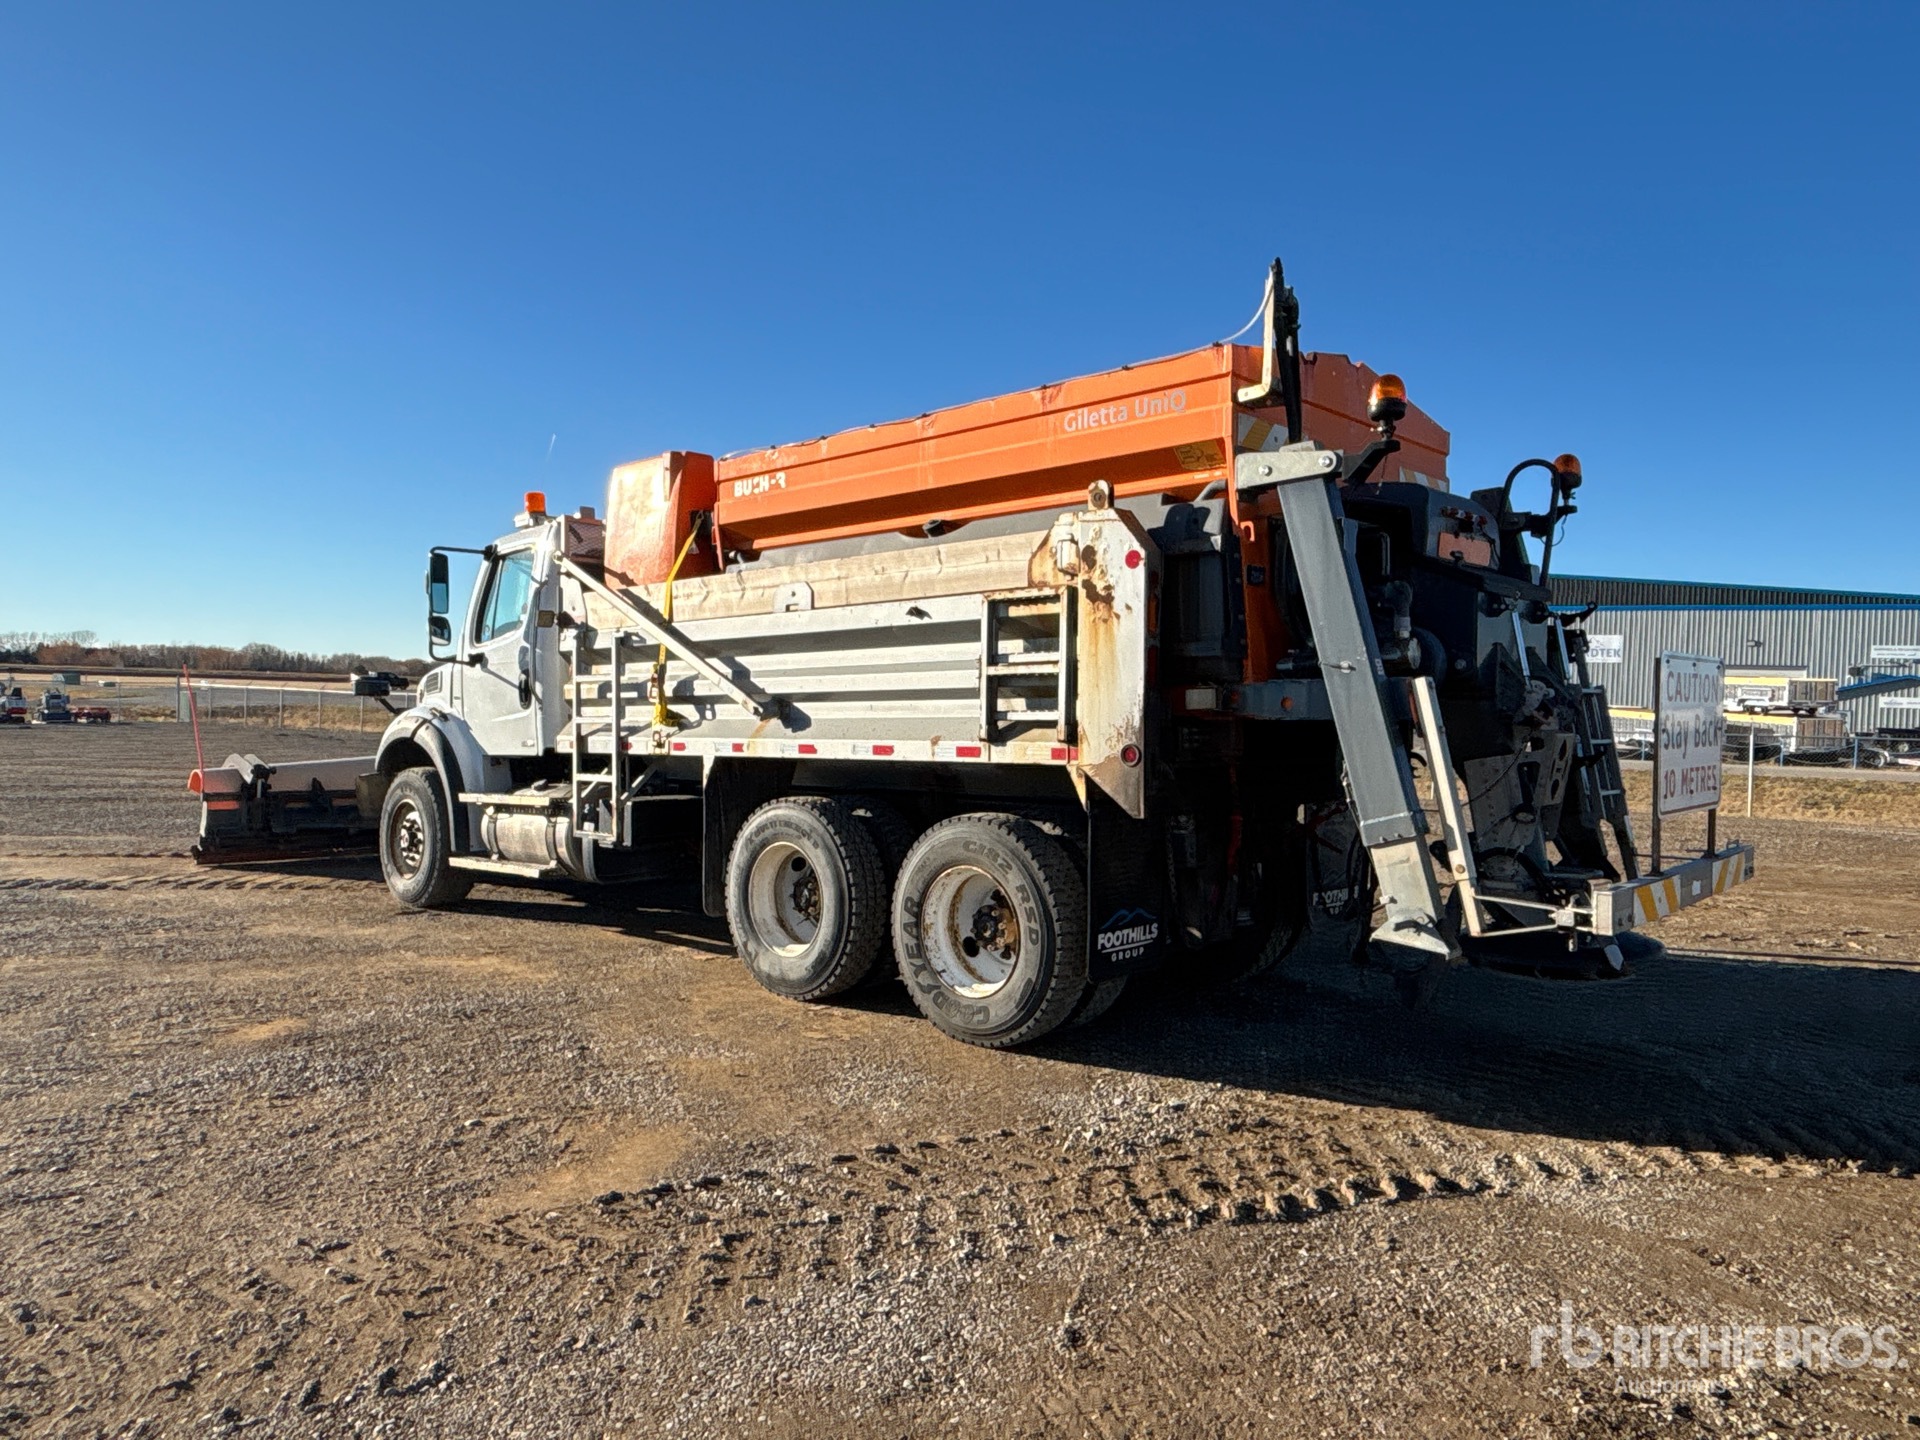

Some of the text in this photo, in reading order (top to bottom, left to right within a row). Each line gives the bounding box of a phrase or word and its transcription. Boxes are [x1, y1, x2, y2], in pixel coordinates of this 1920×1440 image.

[1064, 389, 1187, 432] Giletta UniQ
[1666, 670, 1719, 703] CAUTION
[1664, 713, 1719, 760] Stay Back
[1664, 764, 1718, 800] 10 METRES
[1015, 883, 1040, 947] RSD
[1097, 922, 1159, 951] FOOTHILLS
[1111, 946, 1145, 962] GROUP
